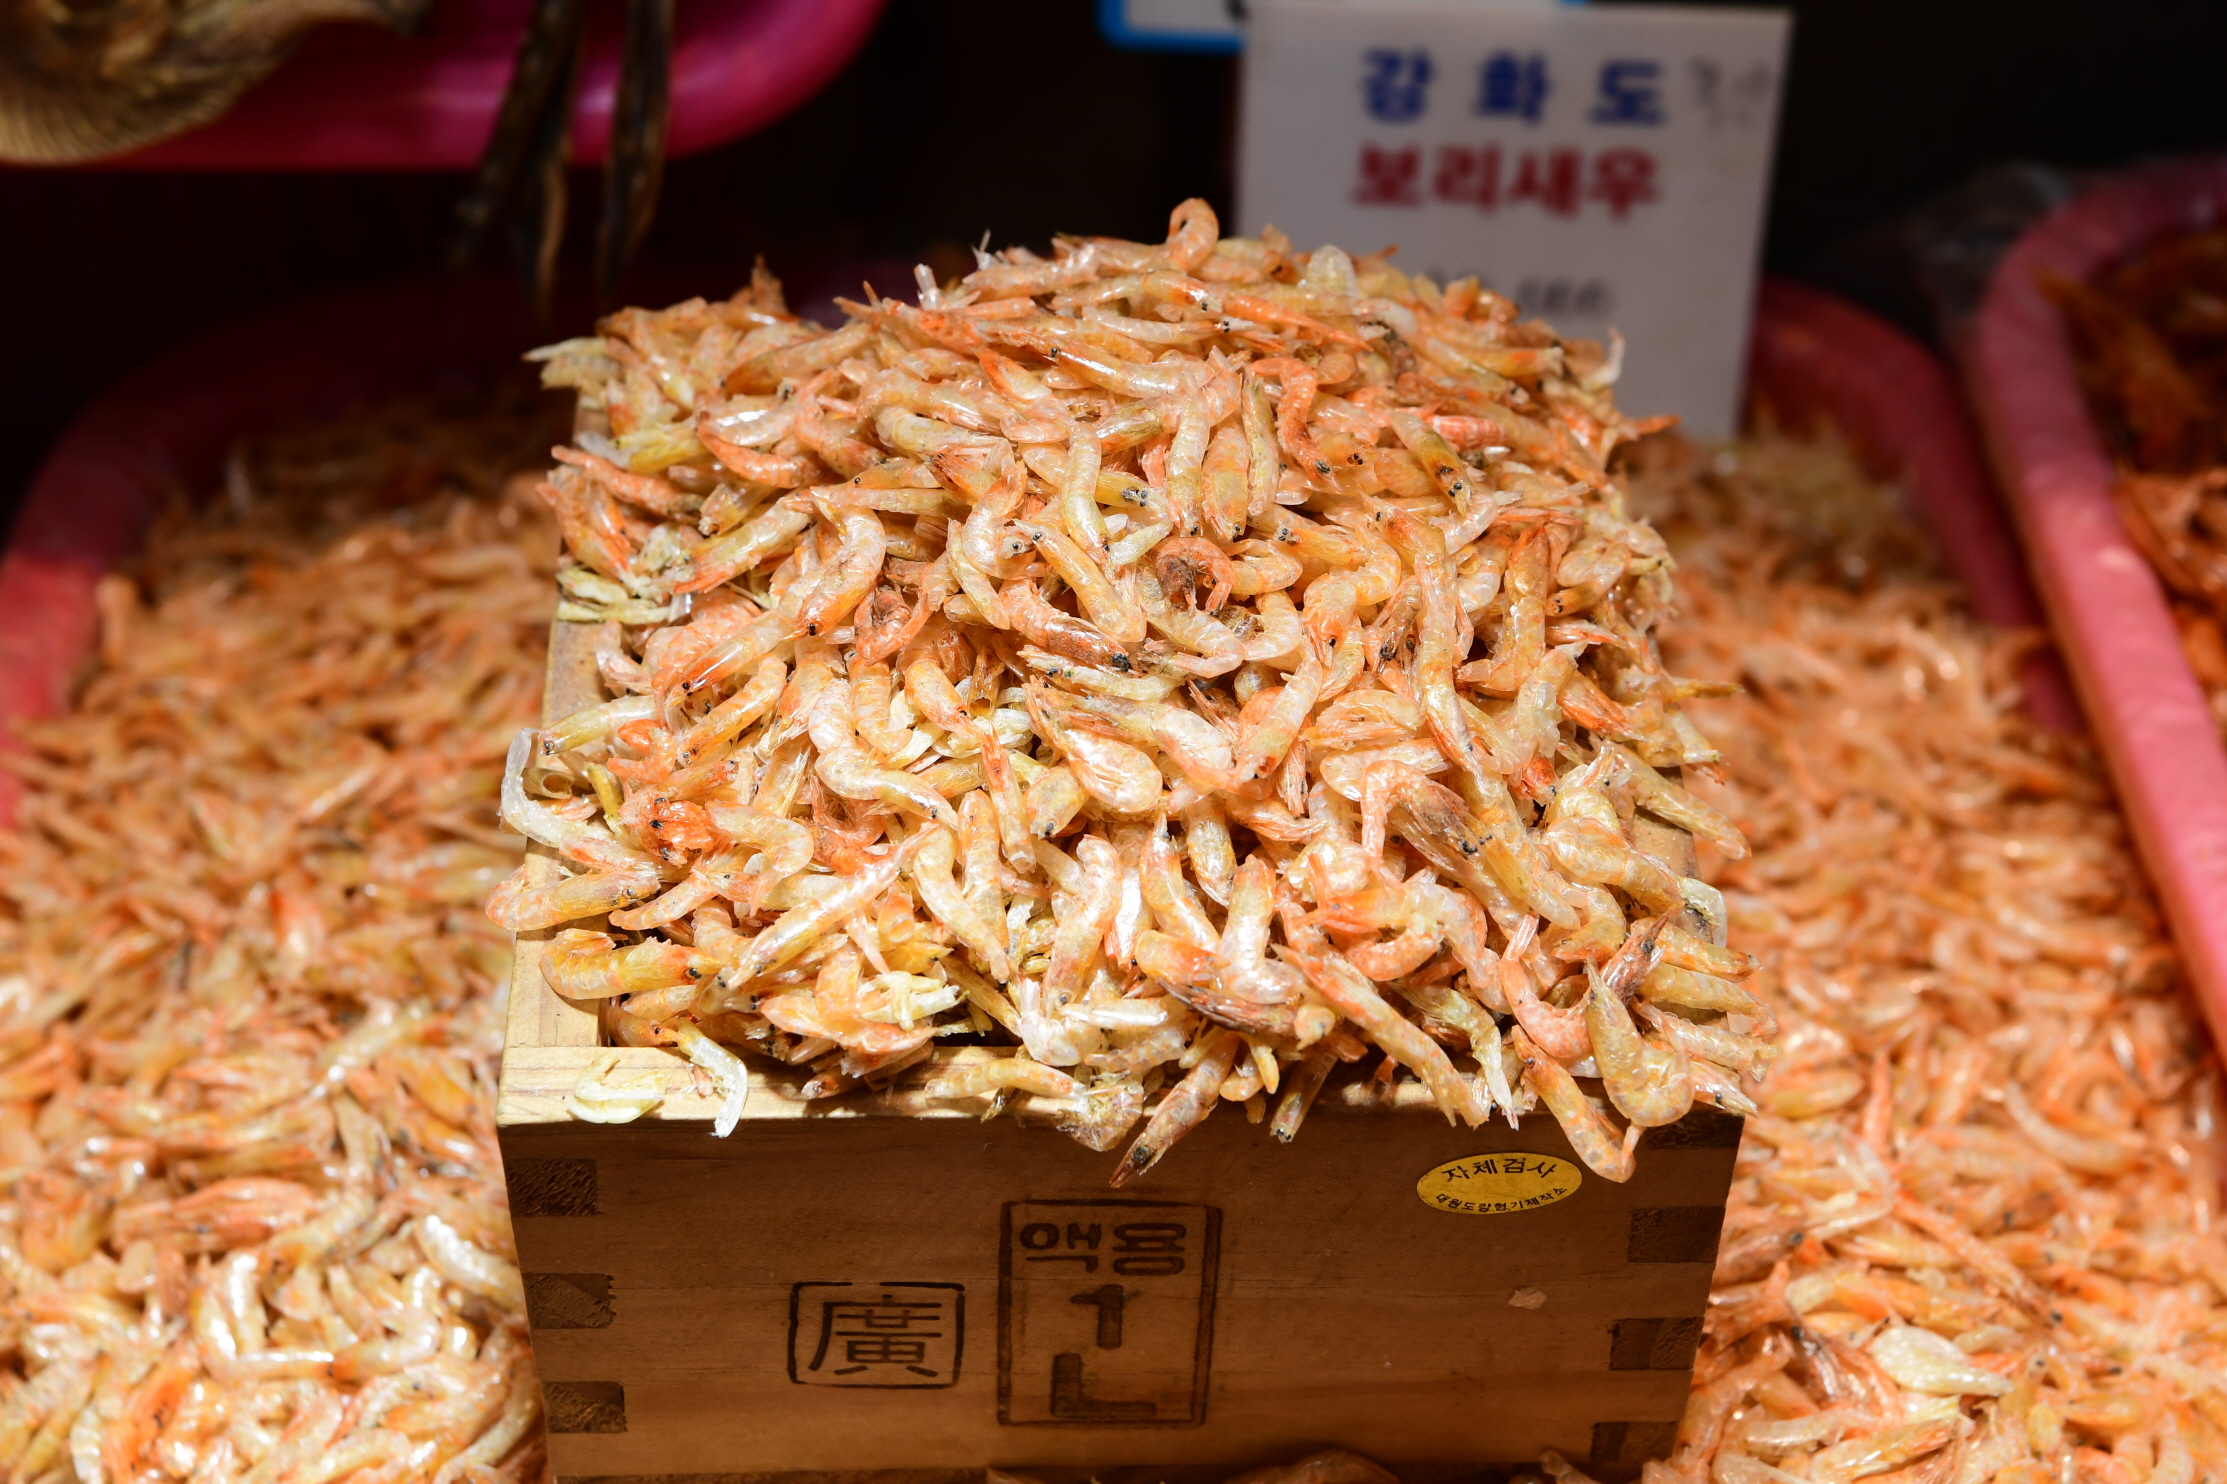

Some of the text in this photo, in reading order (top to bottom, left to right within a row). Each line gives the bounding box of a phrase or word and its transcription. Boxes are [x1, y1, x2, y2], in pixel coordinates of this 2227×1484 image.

[1362, 46, 1667, 126] 강화도
[1351, 140, 1661, 220] 보리새우
[1441, 1157, 1558, 1182] 자체검사
[1020, 1223, 1187, 1276] 액용
[808, 1294, 943, 1377] 廣
[1071, 1284, 1125, 1350] 1
[1050, 1353, 1157, 1418] L
